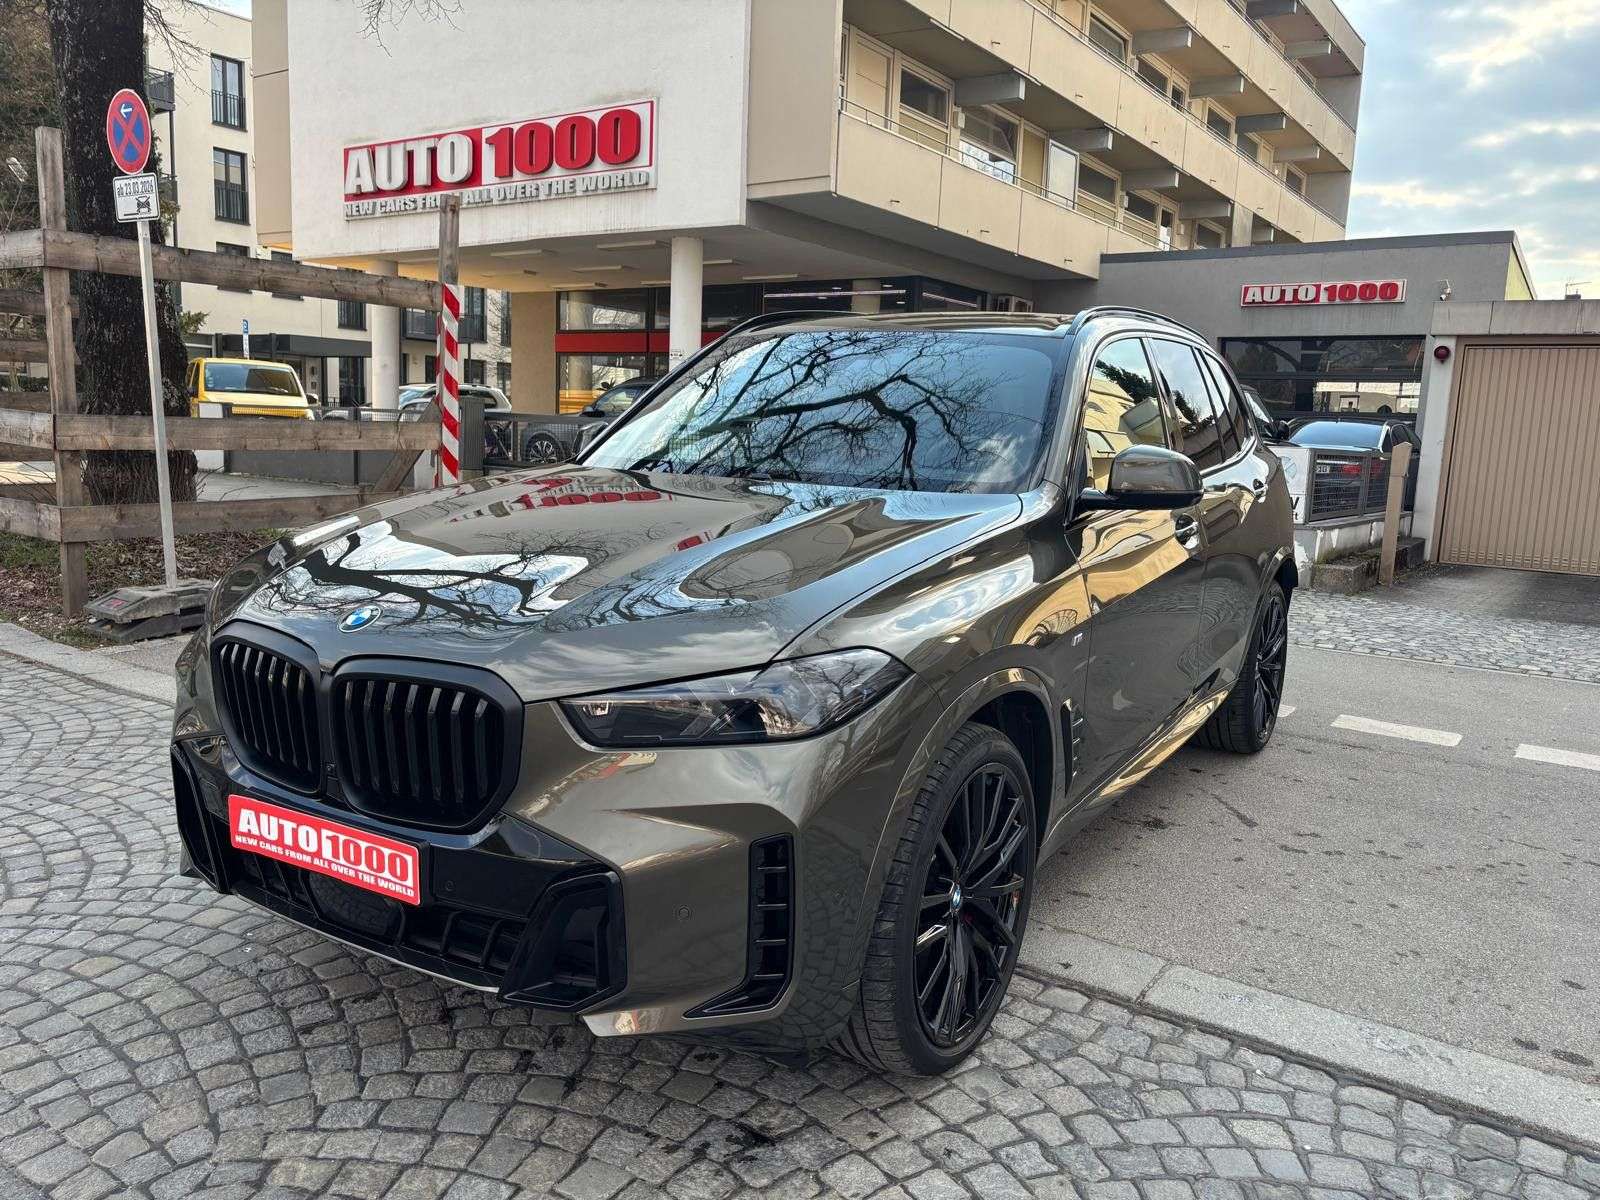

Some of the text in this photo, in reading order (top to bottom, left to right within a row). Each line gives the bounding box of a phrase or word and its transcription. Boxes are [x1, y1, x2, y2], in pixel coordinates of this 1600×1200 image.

[345, 108, 641, 195] AUTO 1000
[345, 171, 649, 217] NEW CARS FR ALL OVER THE WORLD
[1245, 283, 1399, 303] AUTO 1000
[235, 834, 415, 897] NEW CARS FROM ALL OVER THE WORLD
[238, 808, 408, 881] AUTO 1000
